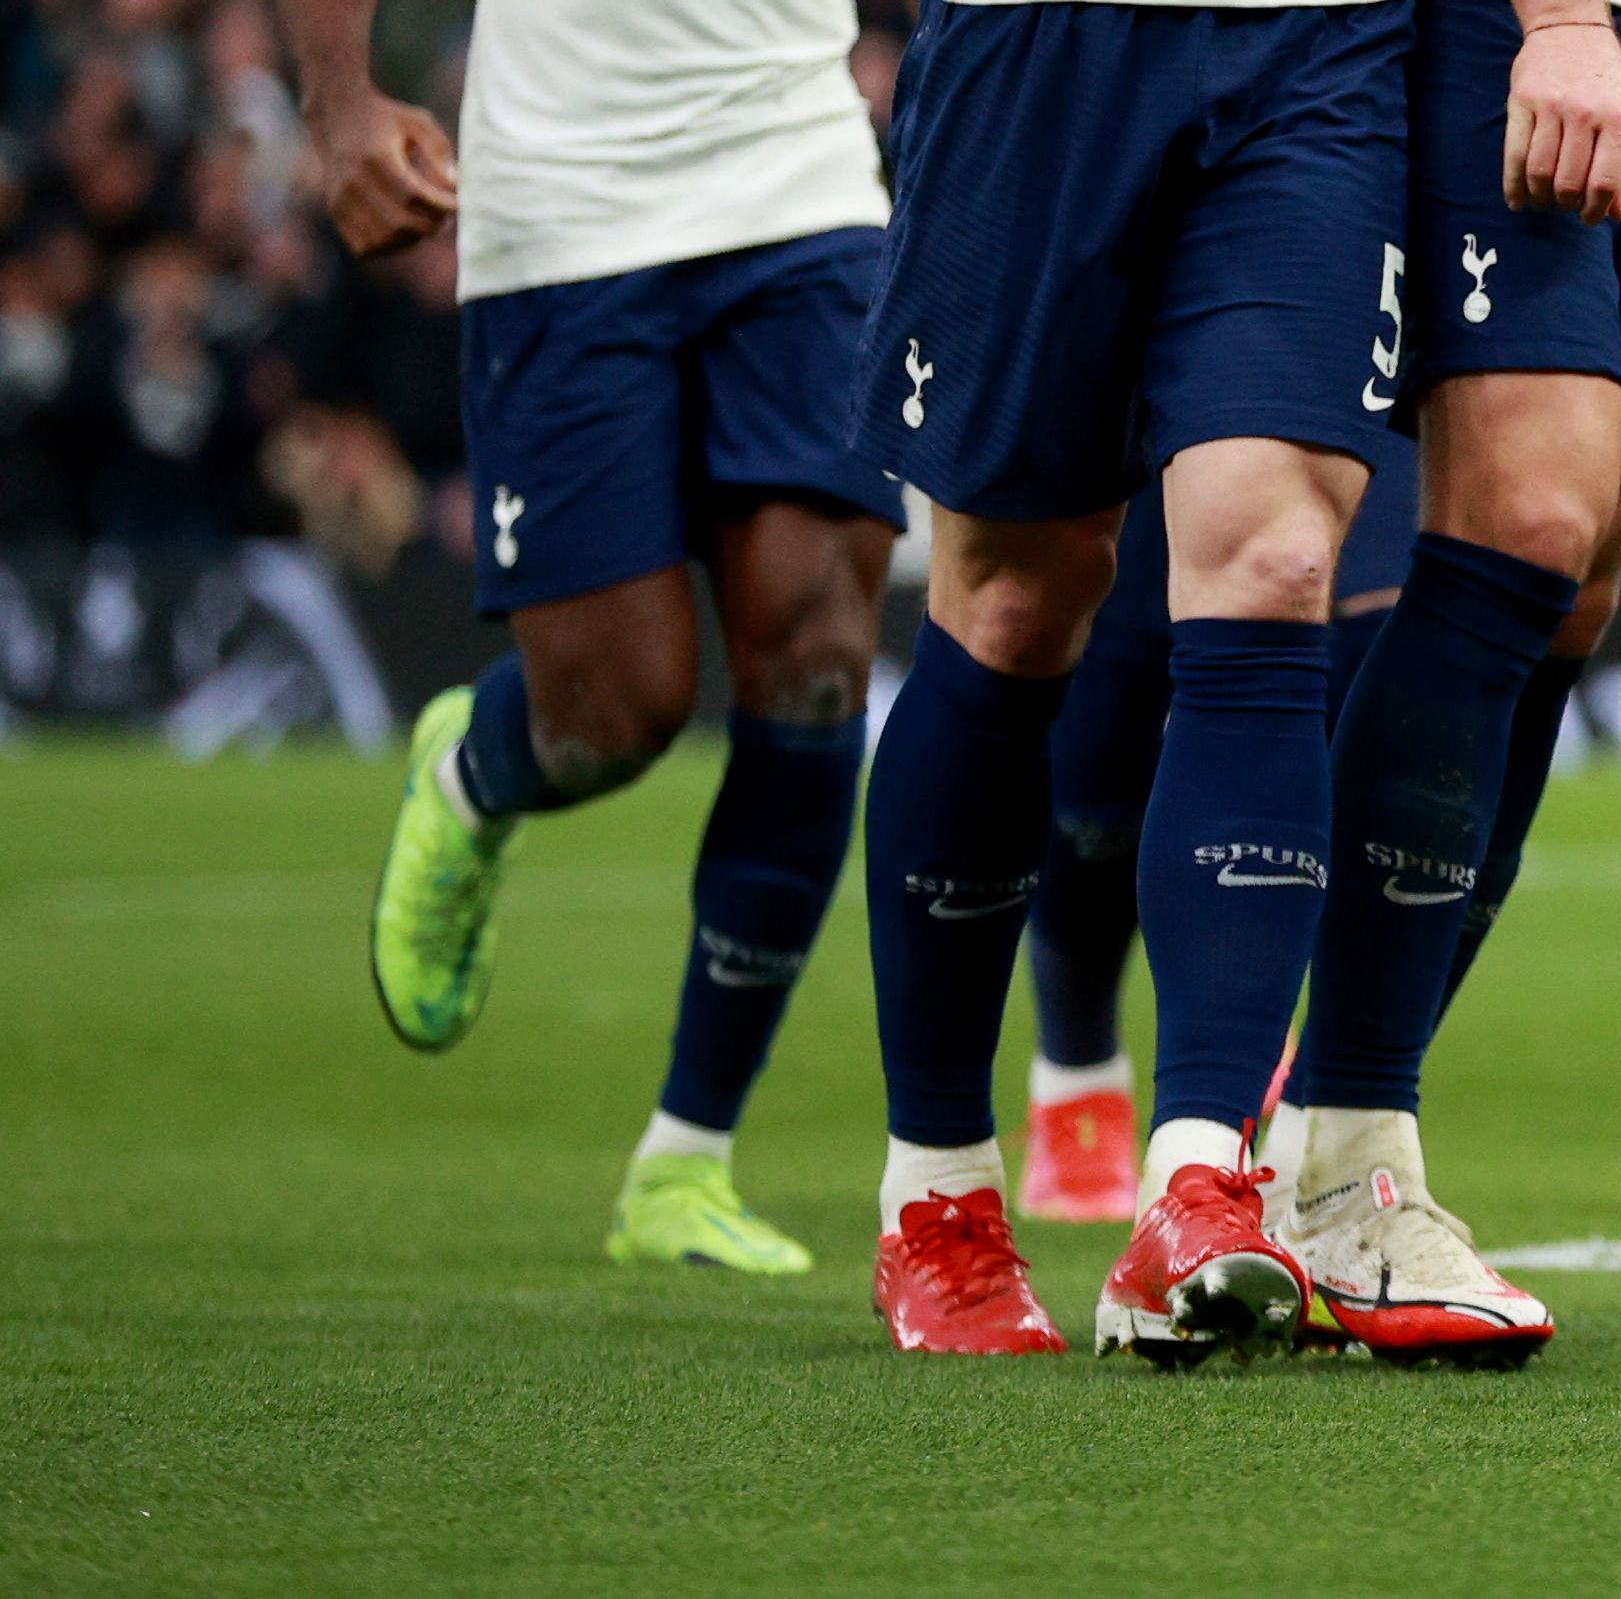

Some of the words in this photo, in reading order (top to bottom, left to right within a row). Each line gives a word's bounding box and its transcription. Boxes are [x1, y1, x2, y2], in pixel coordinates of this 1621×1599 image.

[1371, 240, 1406, 380] 5
[1195, 843, 1328, 889] SPURS
[1365, 842, 1477, 890] SPURS
